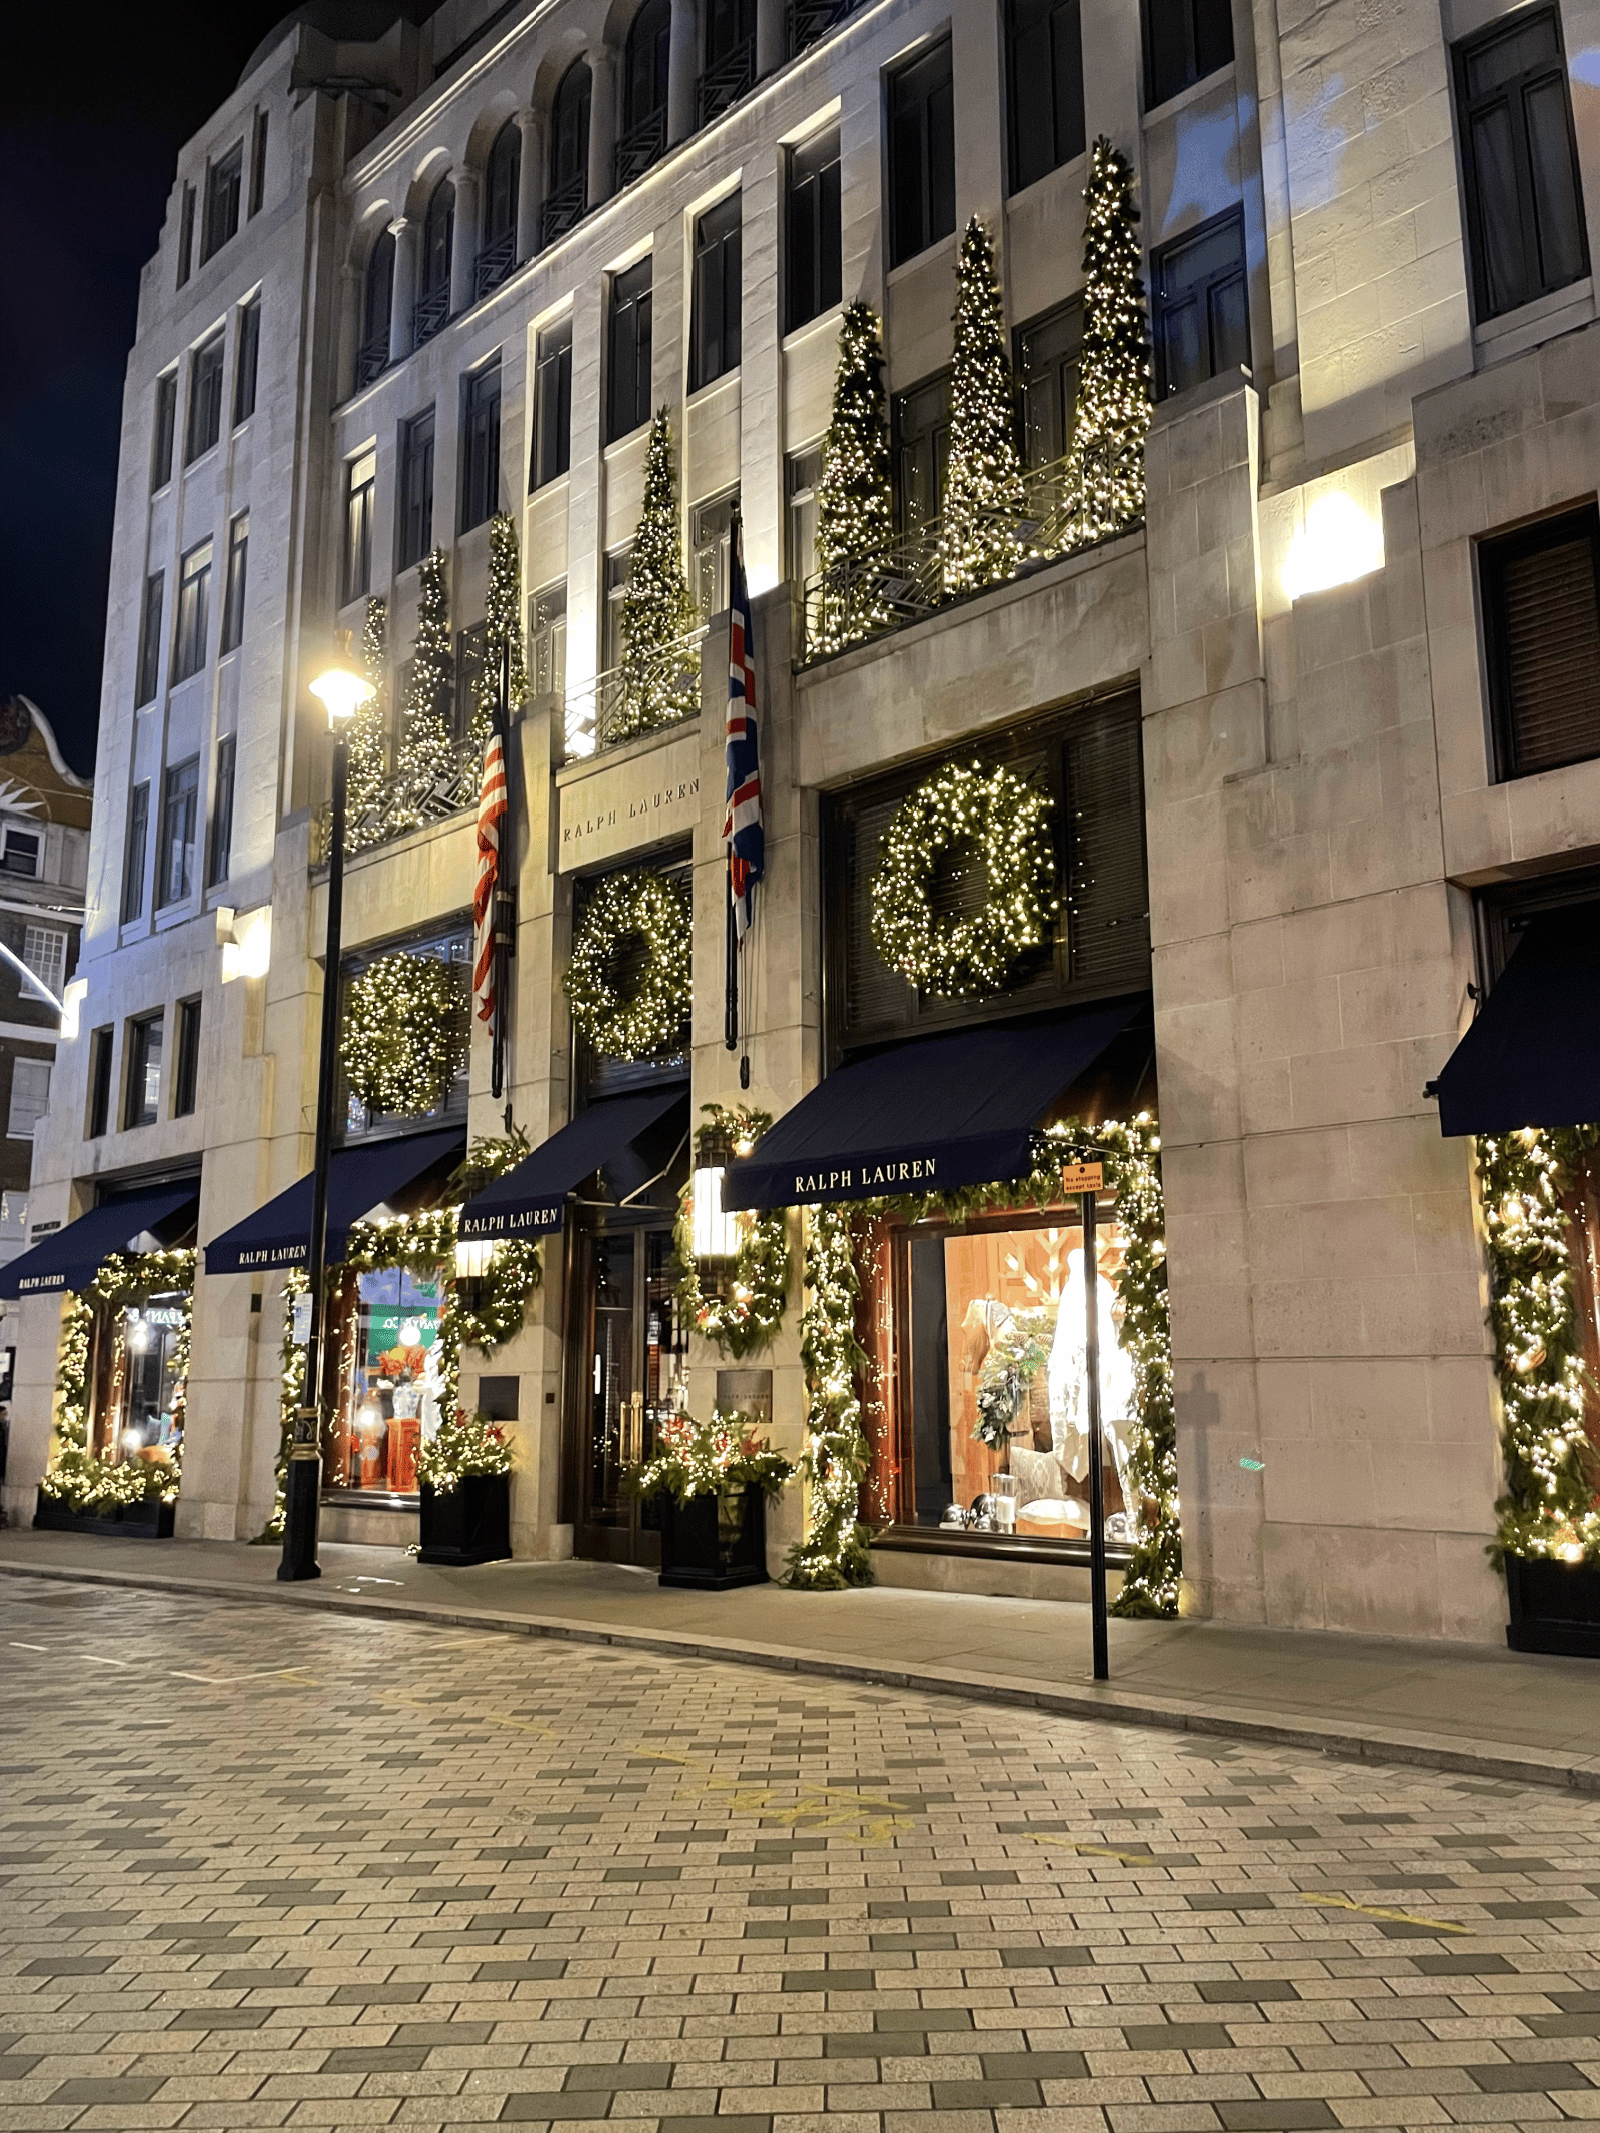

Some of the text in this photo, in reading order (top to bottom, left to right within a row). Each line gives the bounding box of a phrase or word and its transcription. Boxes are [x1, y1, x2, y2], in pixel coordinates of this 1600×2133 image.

[563, 778, 699, 842] RALPH LAUREN
[794, 1158, 936, 1193] RALPH LAUREN
[464, 1207, 558, 1233] RALPH LAUREN
[238, 1244, 307, 1264] RALPH LAUREN
[18, 1274, 66, 1289] RALPH LAUREN
